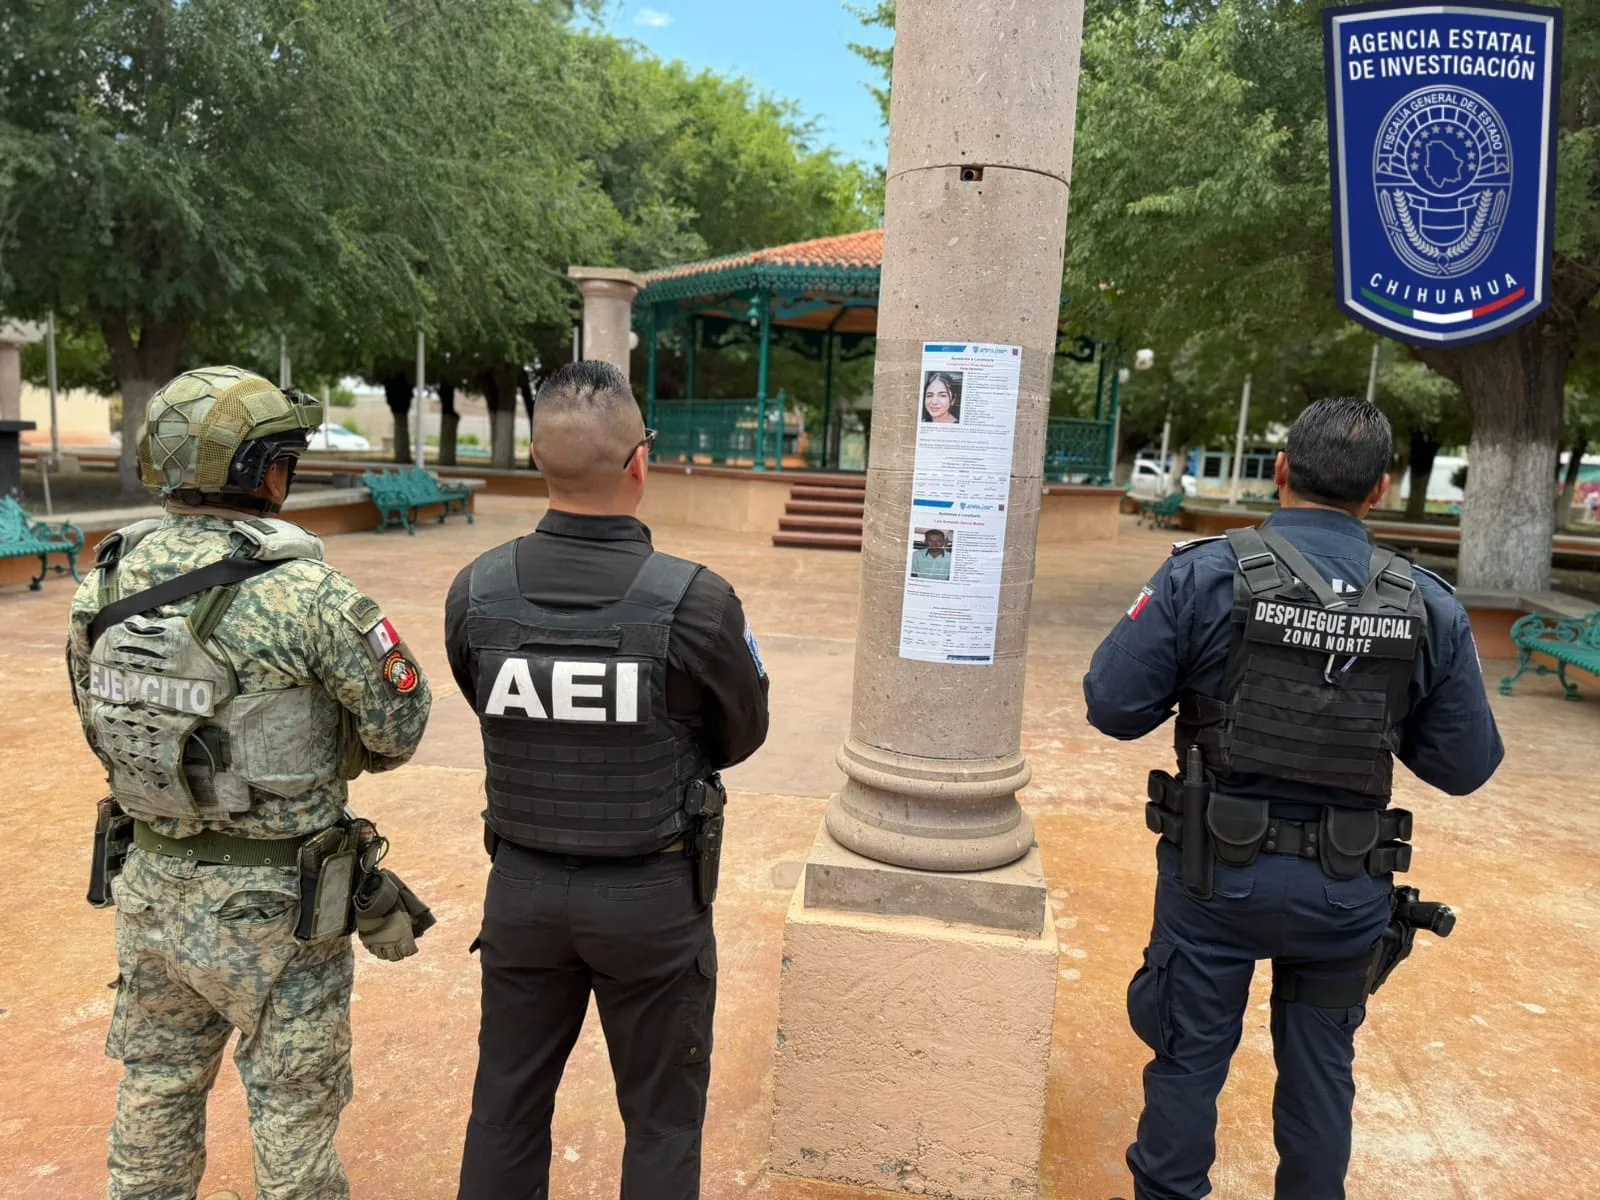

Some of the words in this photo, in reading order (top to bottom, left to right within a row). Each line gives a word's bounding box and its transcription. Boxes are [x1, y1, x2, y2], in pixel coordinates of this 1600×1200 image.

[1255, 601, 1347, 635] DESPLIEGUE
[1350, 616, 1413, 640] POLICIAL
[1283, 628, 1321, 648] ZONA
[1325, 635, 1372, 653] NORTE
[485, 657, 639, 723] AEI
